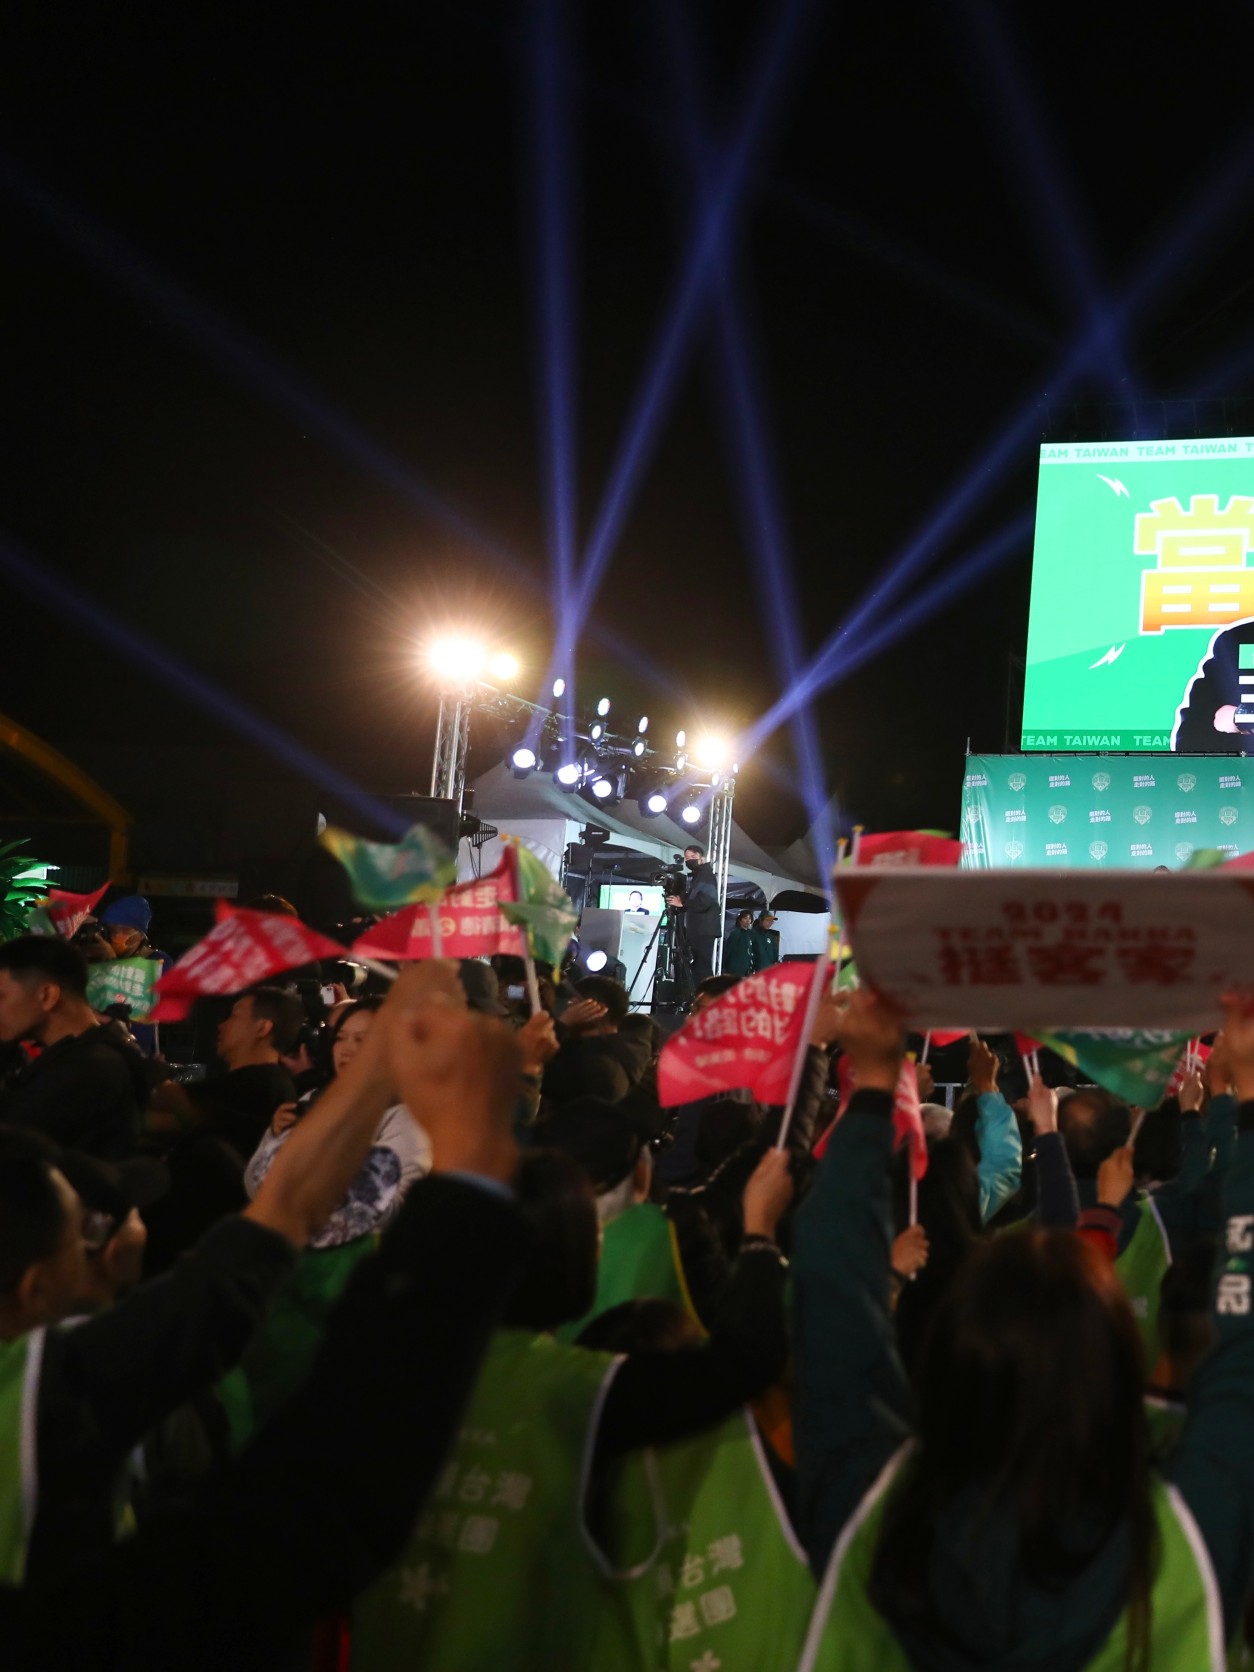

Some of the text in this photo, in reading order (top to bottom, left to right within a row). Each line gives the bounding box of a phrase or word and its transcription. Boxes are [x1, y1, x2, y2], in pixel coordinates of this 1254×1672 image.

[1075, 447, 1129, 458] TAIWAN
[1136, 445, 1176, 457] TEAM
[1181, 443, 1237, 455] TAIWAN
[1063, 735, 1121, 746] TAIWAN
